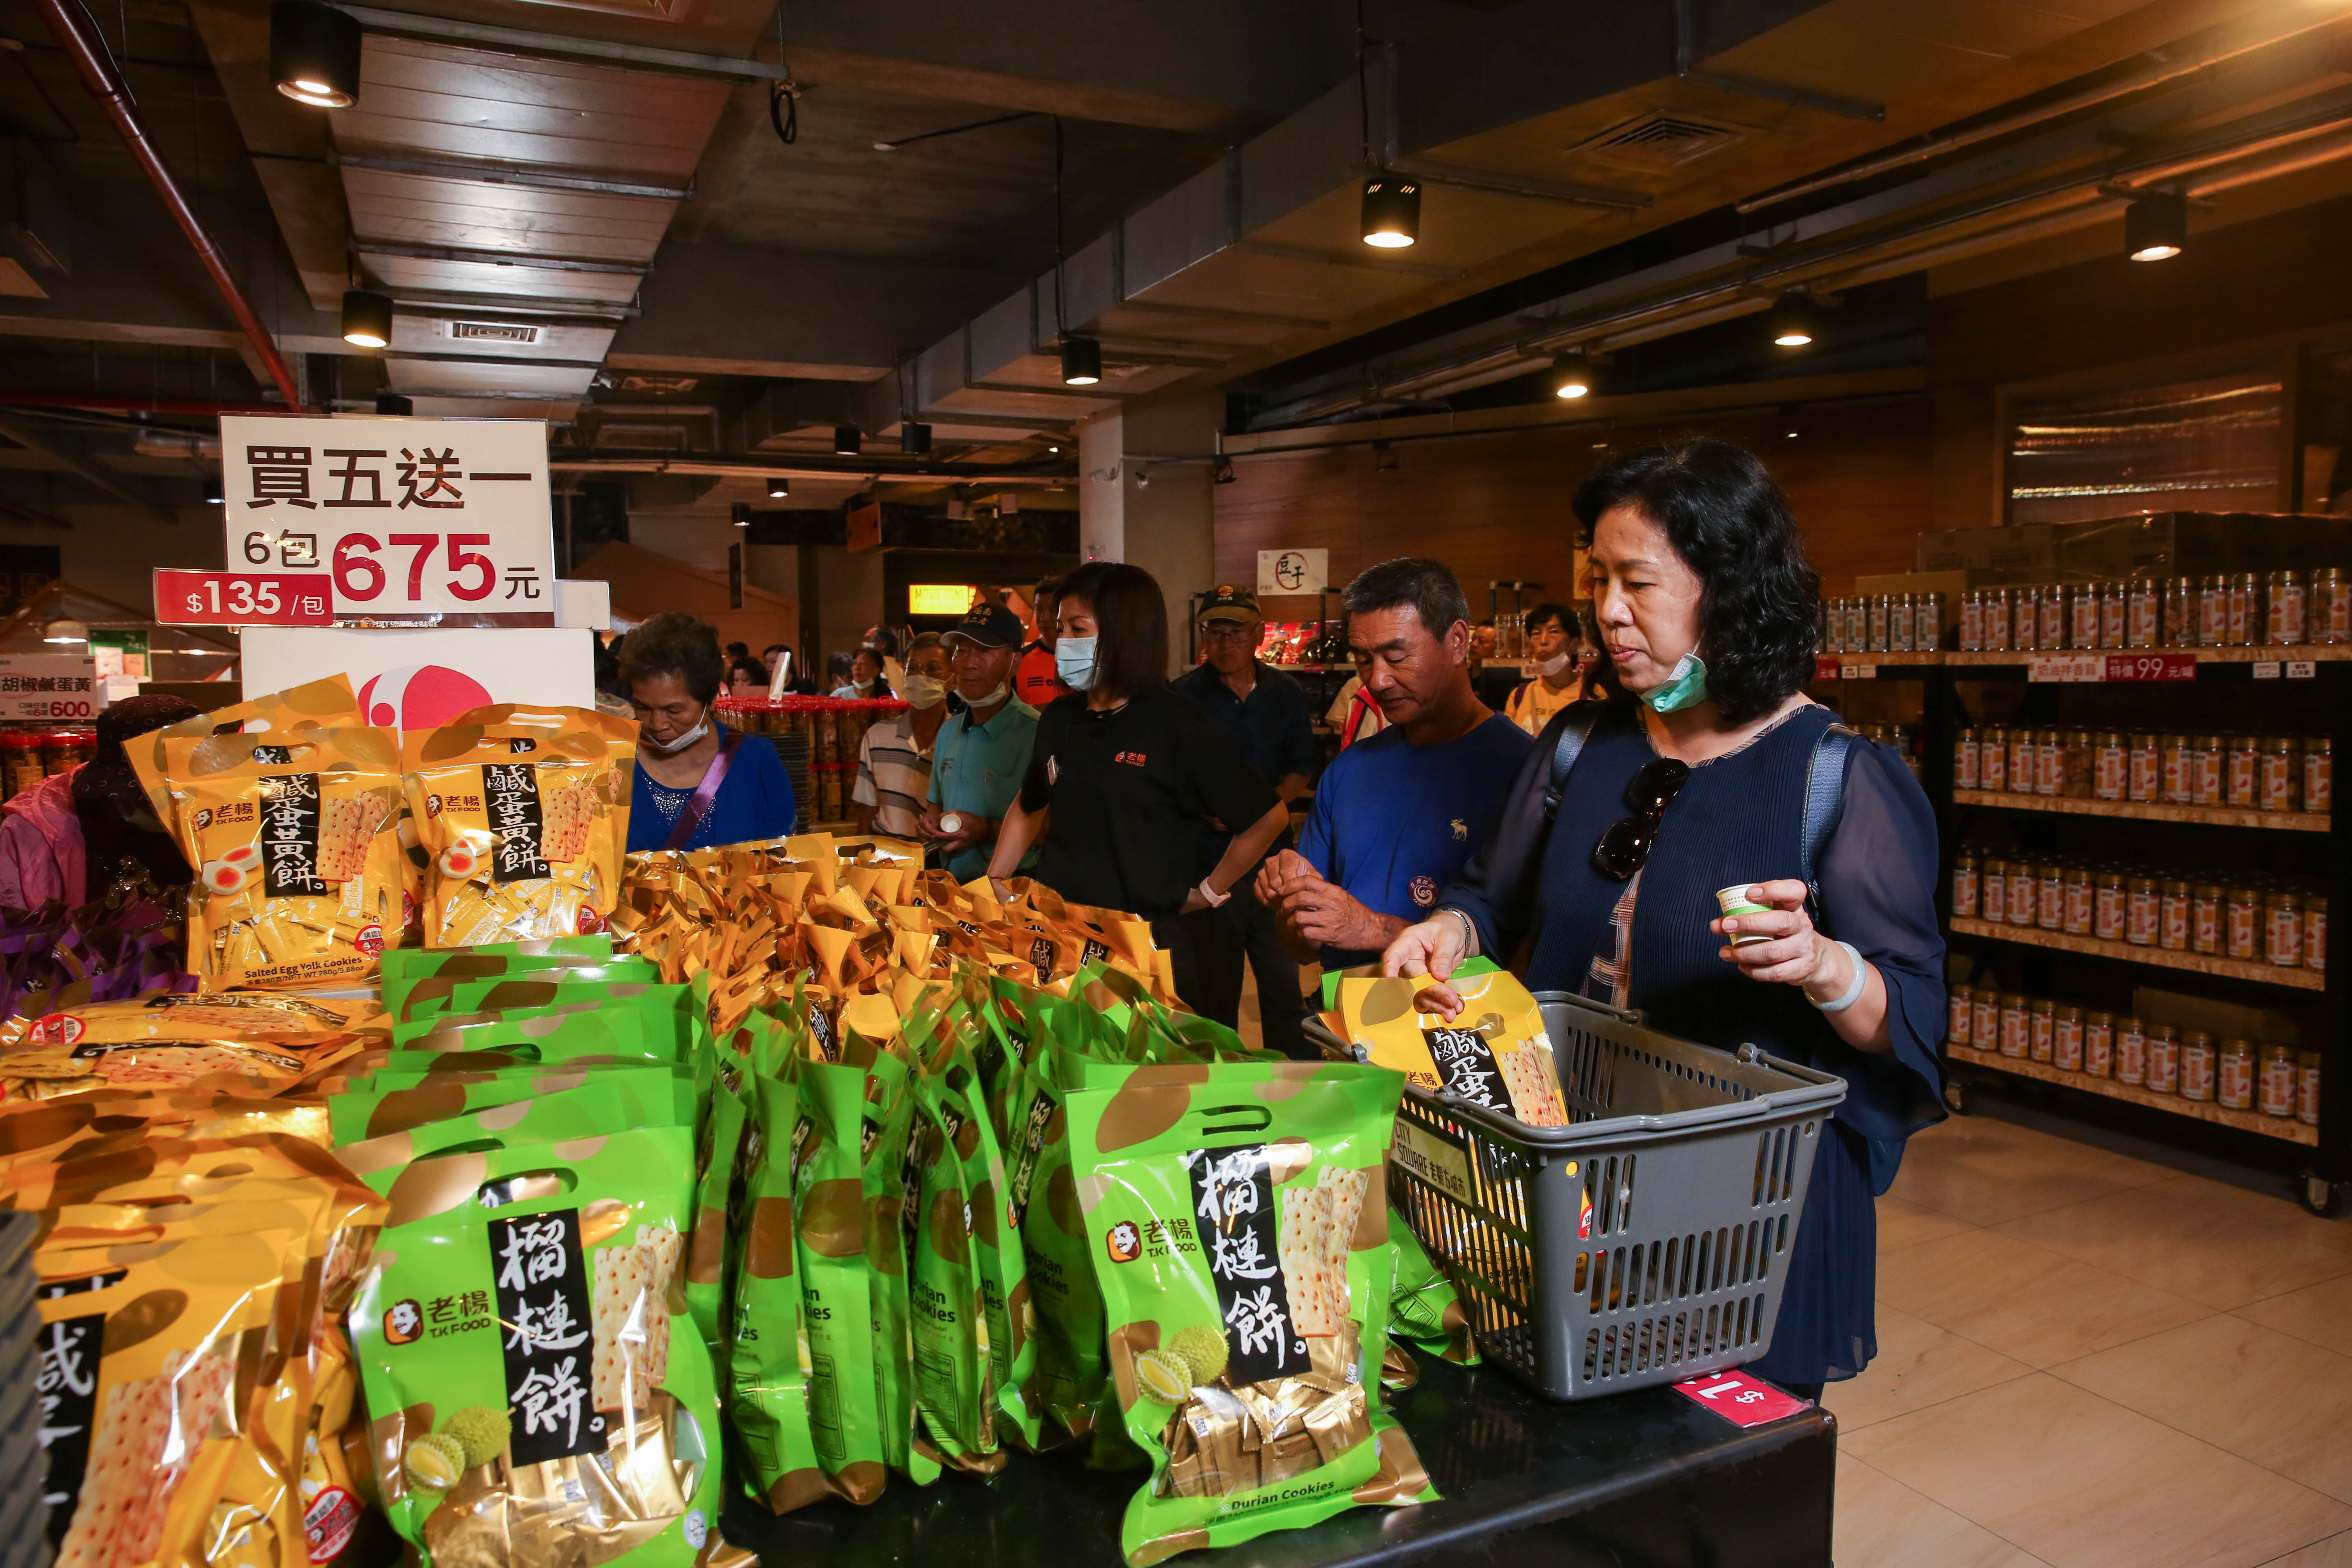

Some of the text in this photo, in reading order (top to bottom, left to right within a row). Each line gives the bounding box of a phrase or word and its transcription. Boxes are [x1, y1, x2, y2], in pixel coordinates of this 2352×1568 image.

[247, 445, 532, 510] 買五送一
[245, 529, 541, 601] 6包 675 元
[186, 580, 325, 616] $135 /包
[2109, 665, 2134, 678] 特價
[2138, 658, 2163, 679] 99
[2, 677, 91, 692] 胡椒鹹蛋黃
[50, 701, 91, 717] 600
[1127, 752, 1146, 763] 老楊
[215, 802, 253, 818] 老楊
[444, 795, 480, 806] 老楊
[245, 957, 362, 978] Salted Egg Yolk Cookies
[1408, 1071, 1438, 1087] 老楊
[1395, 1120, 1411, 1145] CITY
[1397, 1142, 1429, 1177] SQUARE
[1143, 1218, 1193, 1244] 老楊
[426, 1290, 489, 1323] 老楊
[451, 1318, 491, 1334] FOOD
[1231, 1491, 1278, 1510] Durian
[1281, 1481, 1334, 1499] Cookies
